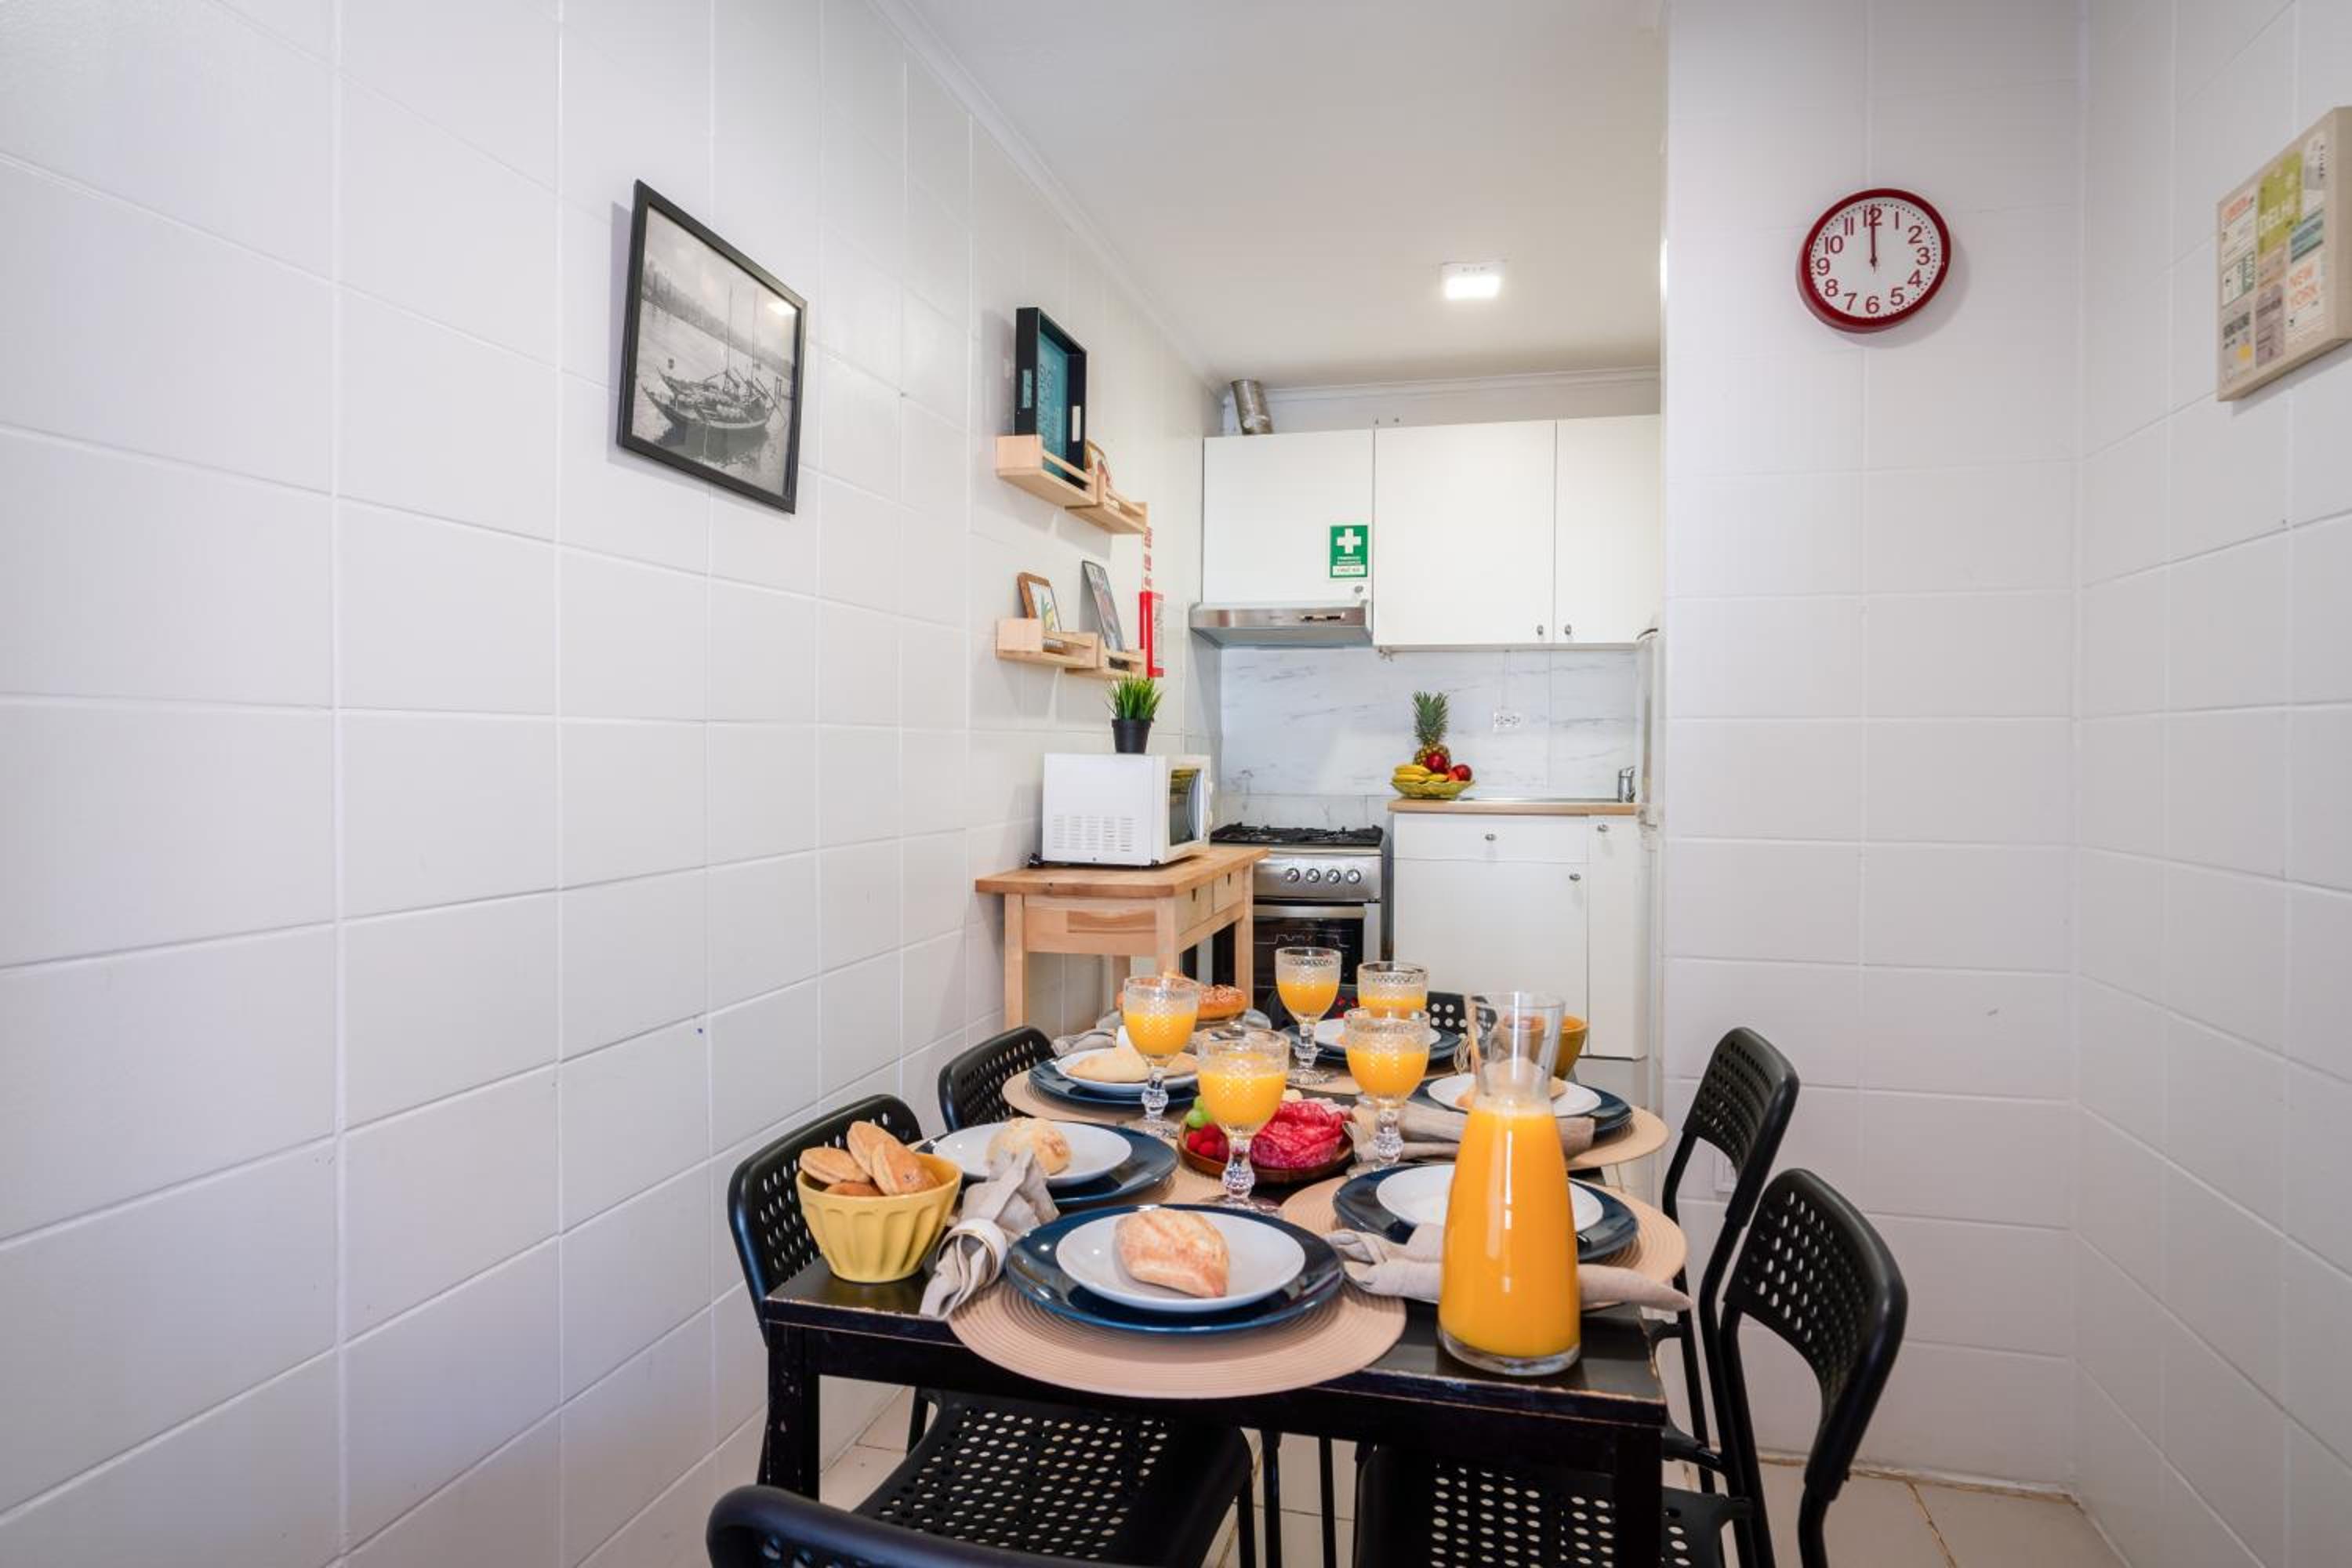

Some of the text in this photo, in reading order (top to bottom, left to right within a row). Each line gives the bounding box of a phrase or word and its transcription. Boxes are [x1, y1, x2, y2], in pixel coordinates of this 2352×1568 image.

[1844, 216, 1854, 236] 11
[1863, 208, 1882, 227] 12
[1894, 210, 1900, 230] 1
[1824, 235, 1843, 254] 10
[1907, 226, 1922, 244] 2
[1916, 247, 1930, 265] 3
[1816, 257, 1831, 276] 9
[1824, 279, 1838, 297] 8
[1907, 270, 1922, 288] 4
[1843, 292, 1857, 311] 7
[1865, 296, 1880, 314] 6
[1890, 287, 1904, 306] 5
